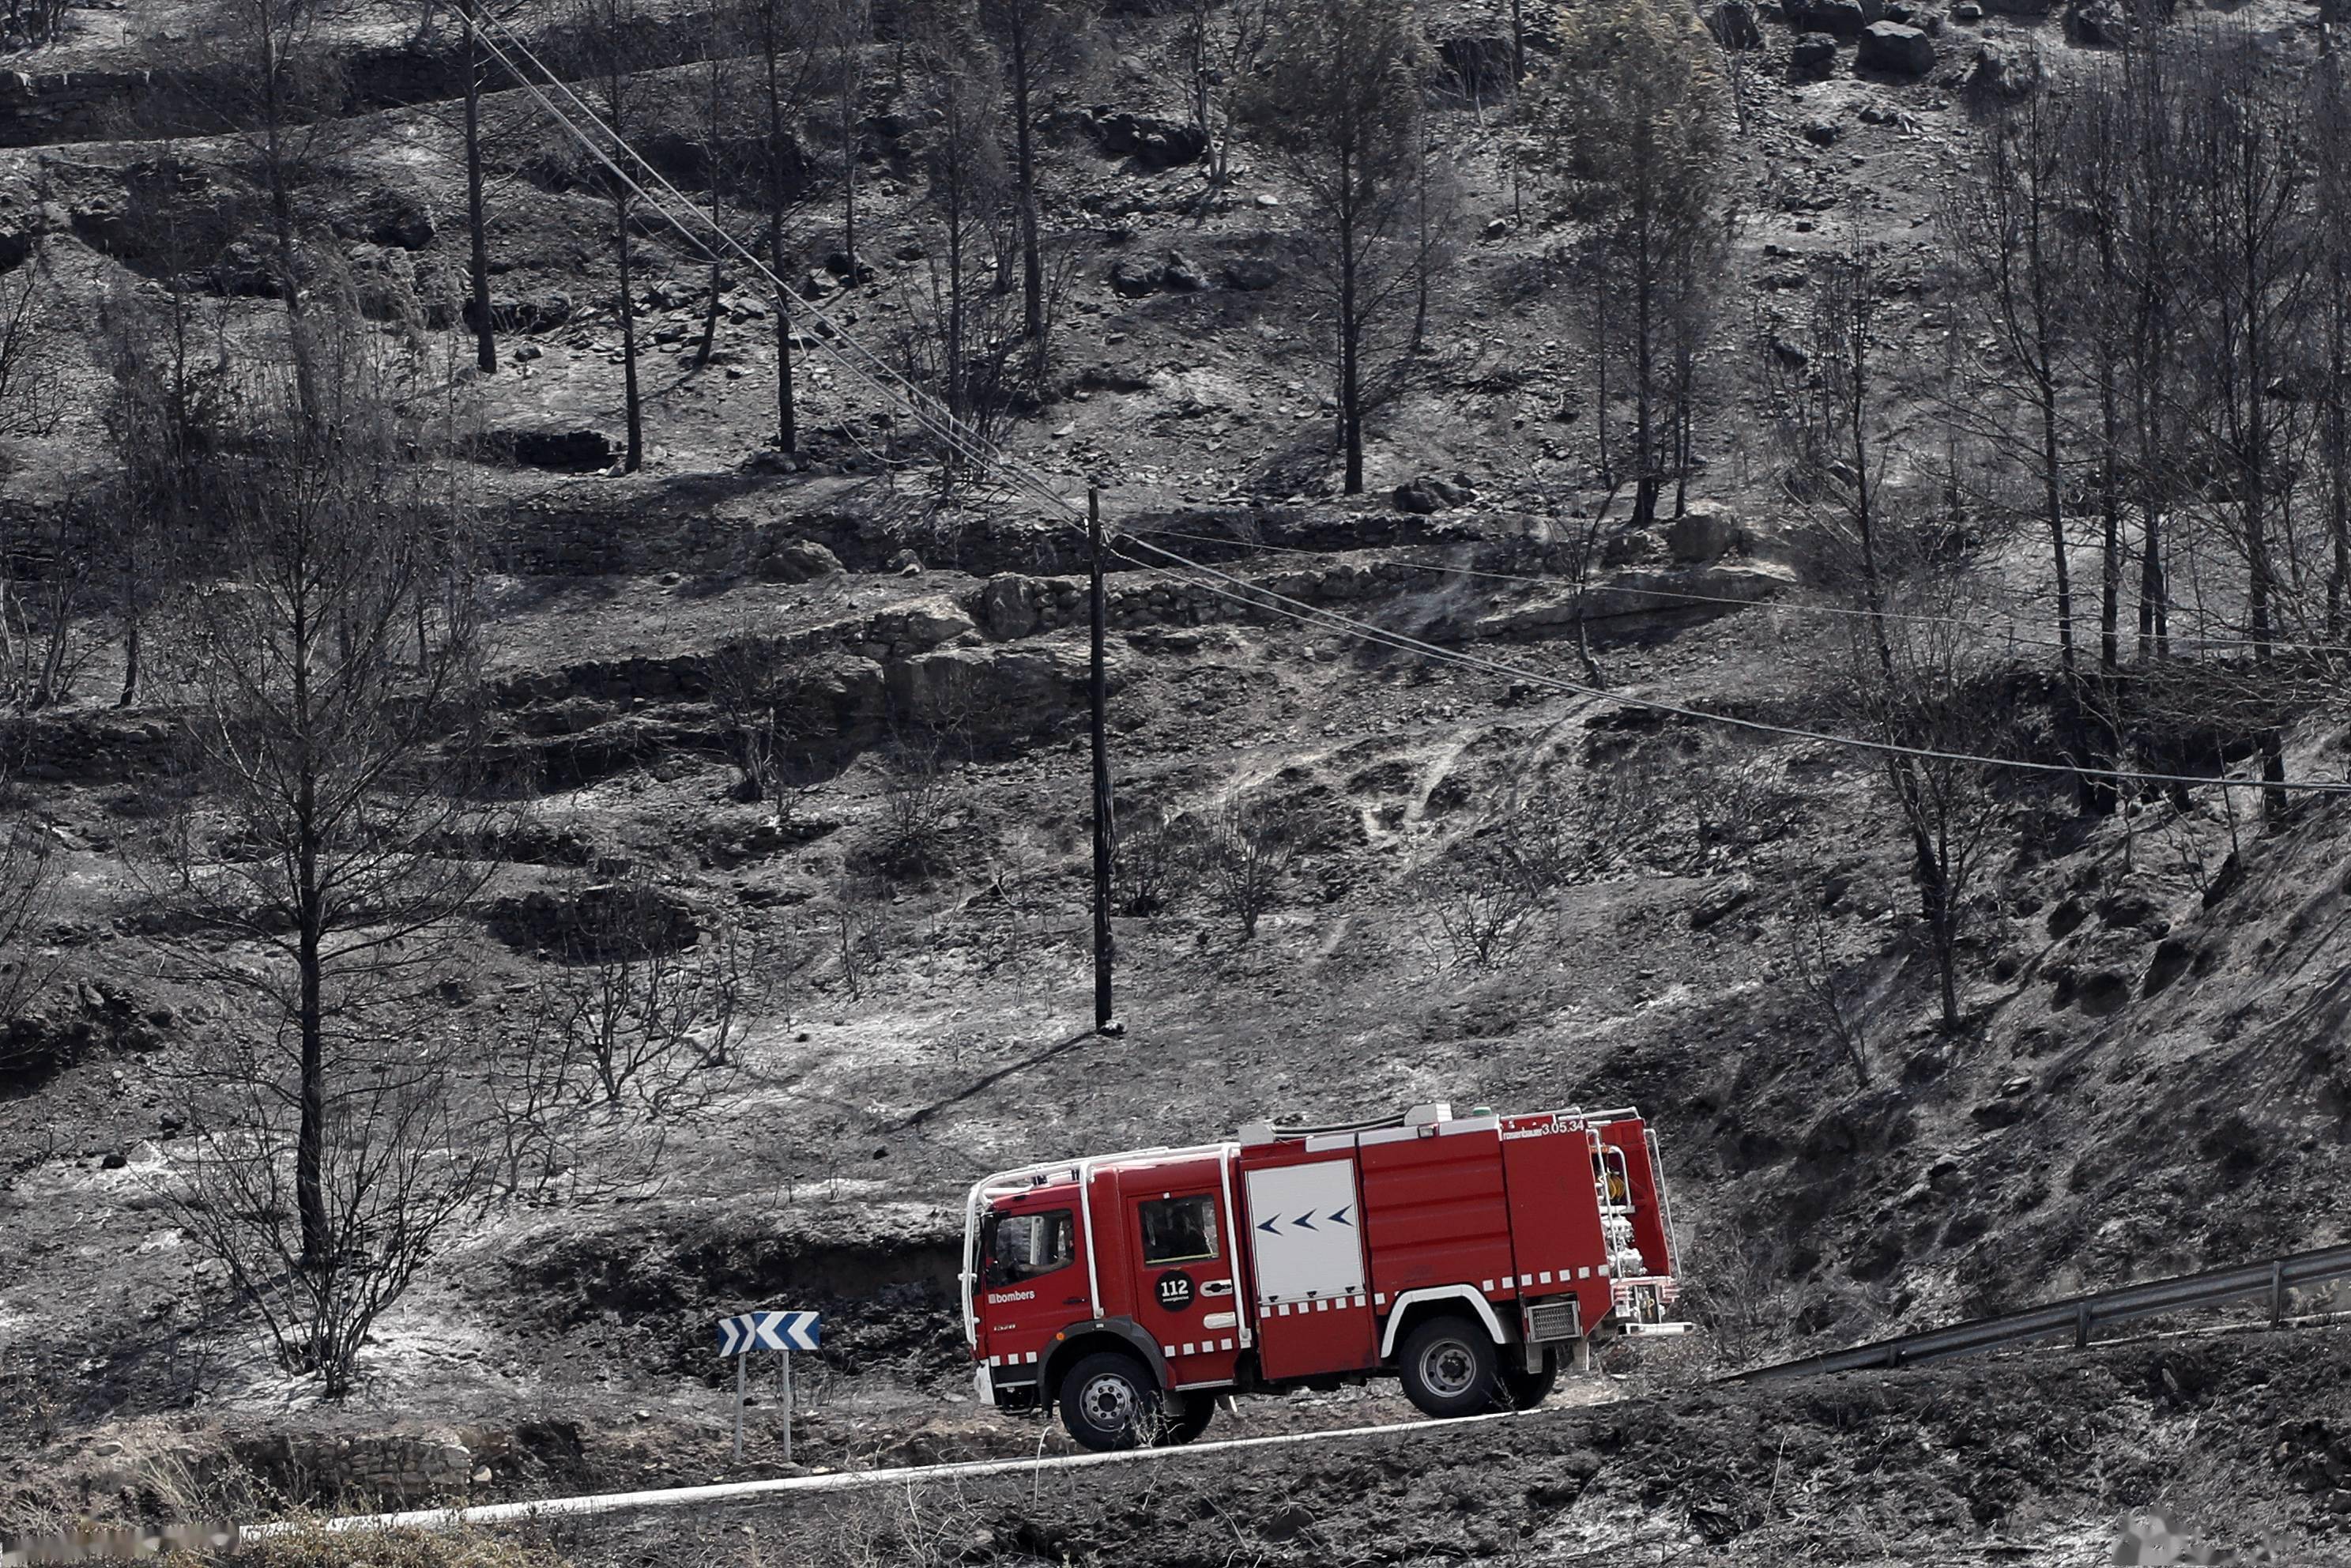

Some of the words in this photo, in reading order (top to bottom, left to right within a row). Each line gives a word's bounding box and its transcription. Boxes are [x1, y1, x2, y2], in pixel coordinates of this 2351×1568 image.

[1542, 1120, 1584, 1136] 3.05.34
[1161, 1280, 1189, 1297] 112
[996, 1291, 1035, 1303] bombers
